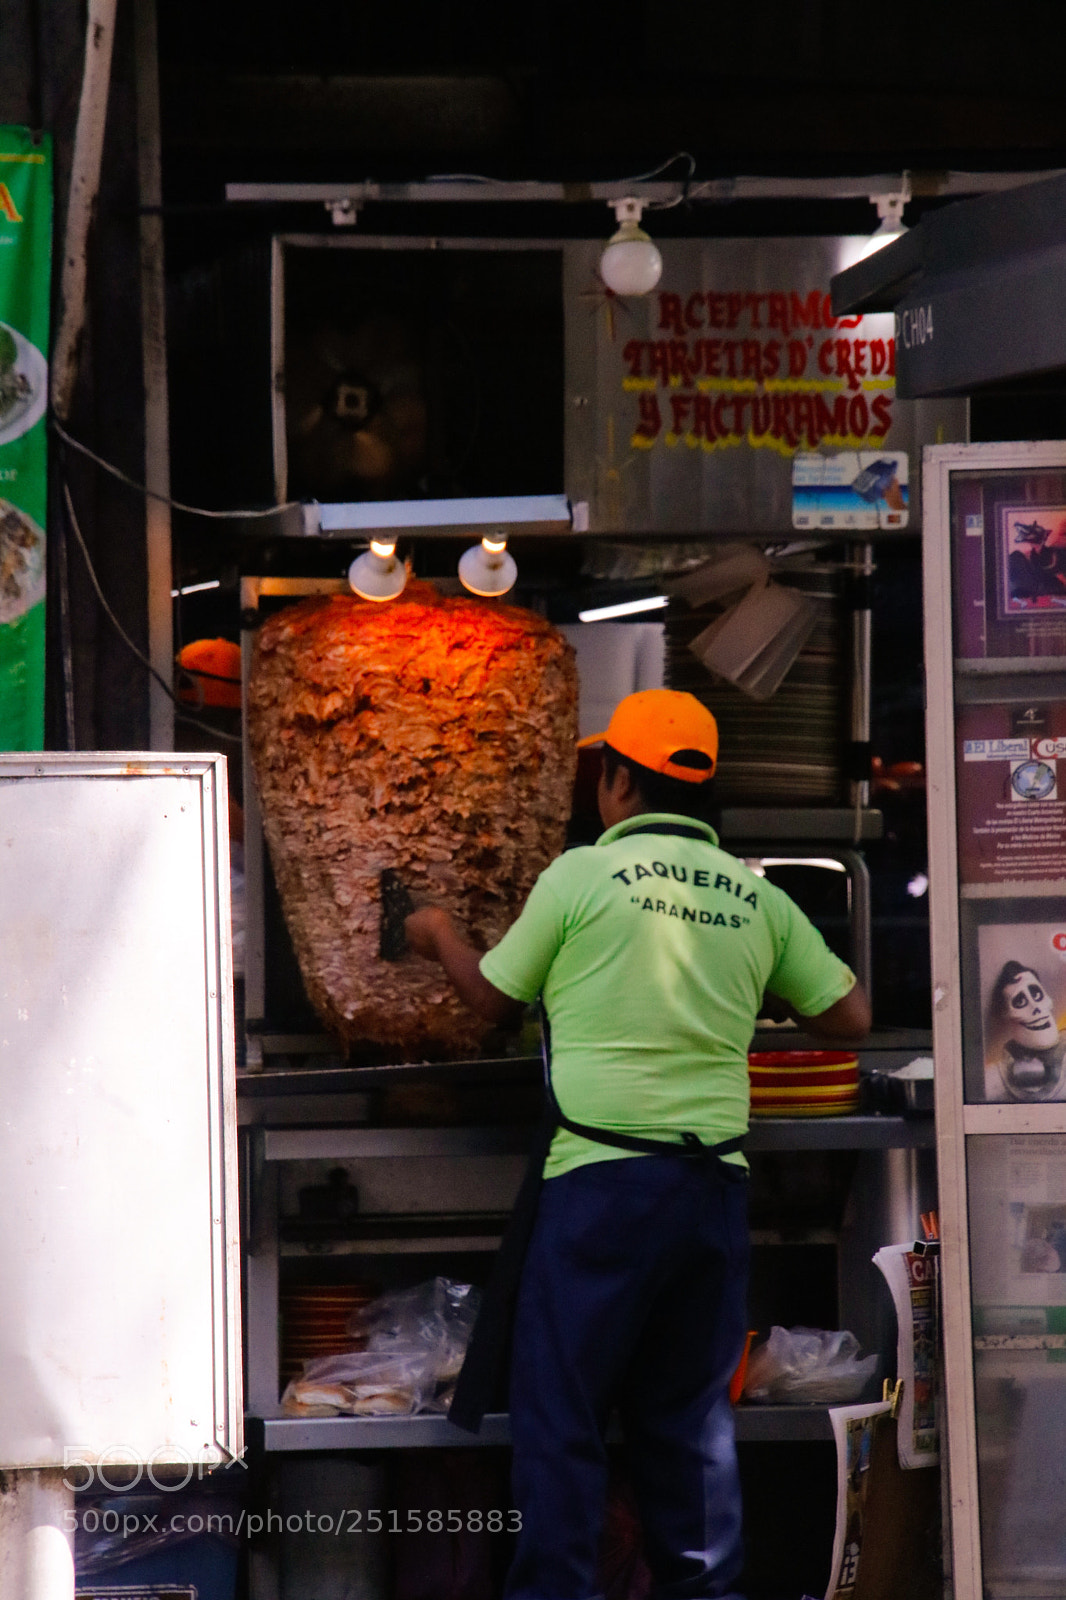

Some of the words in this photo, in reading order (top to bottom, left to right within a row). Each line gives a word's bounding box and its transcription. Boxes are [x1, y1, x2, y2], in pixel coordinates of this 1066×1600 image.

[902, 304, 933, 349] CH04
[622, 337, 781, 389] TARJETAS
[669, 392, 893, 448] FACTURAMOS
[611, 861, 759, 910] TAQUERIA
